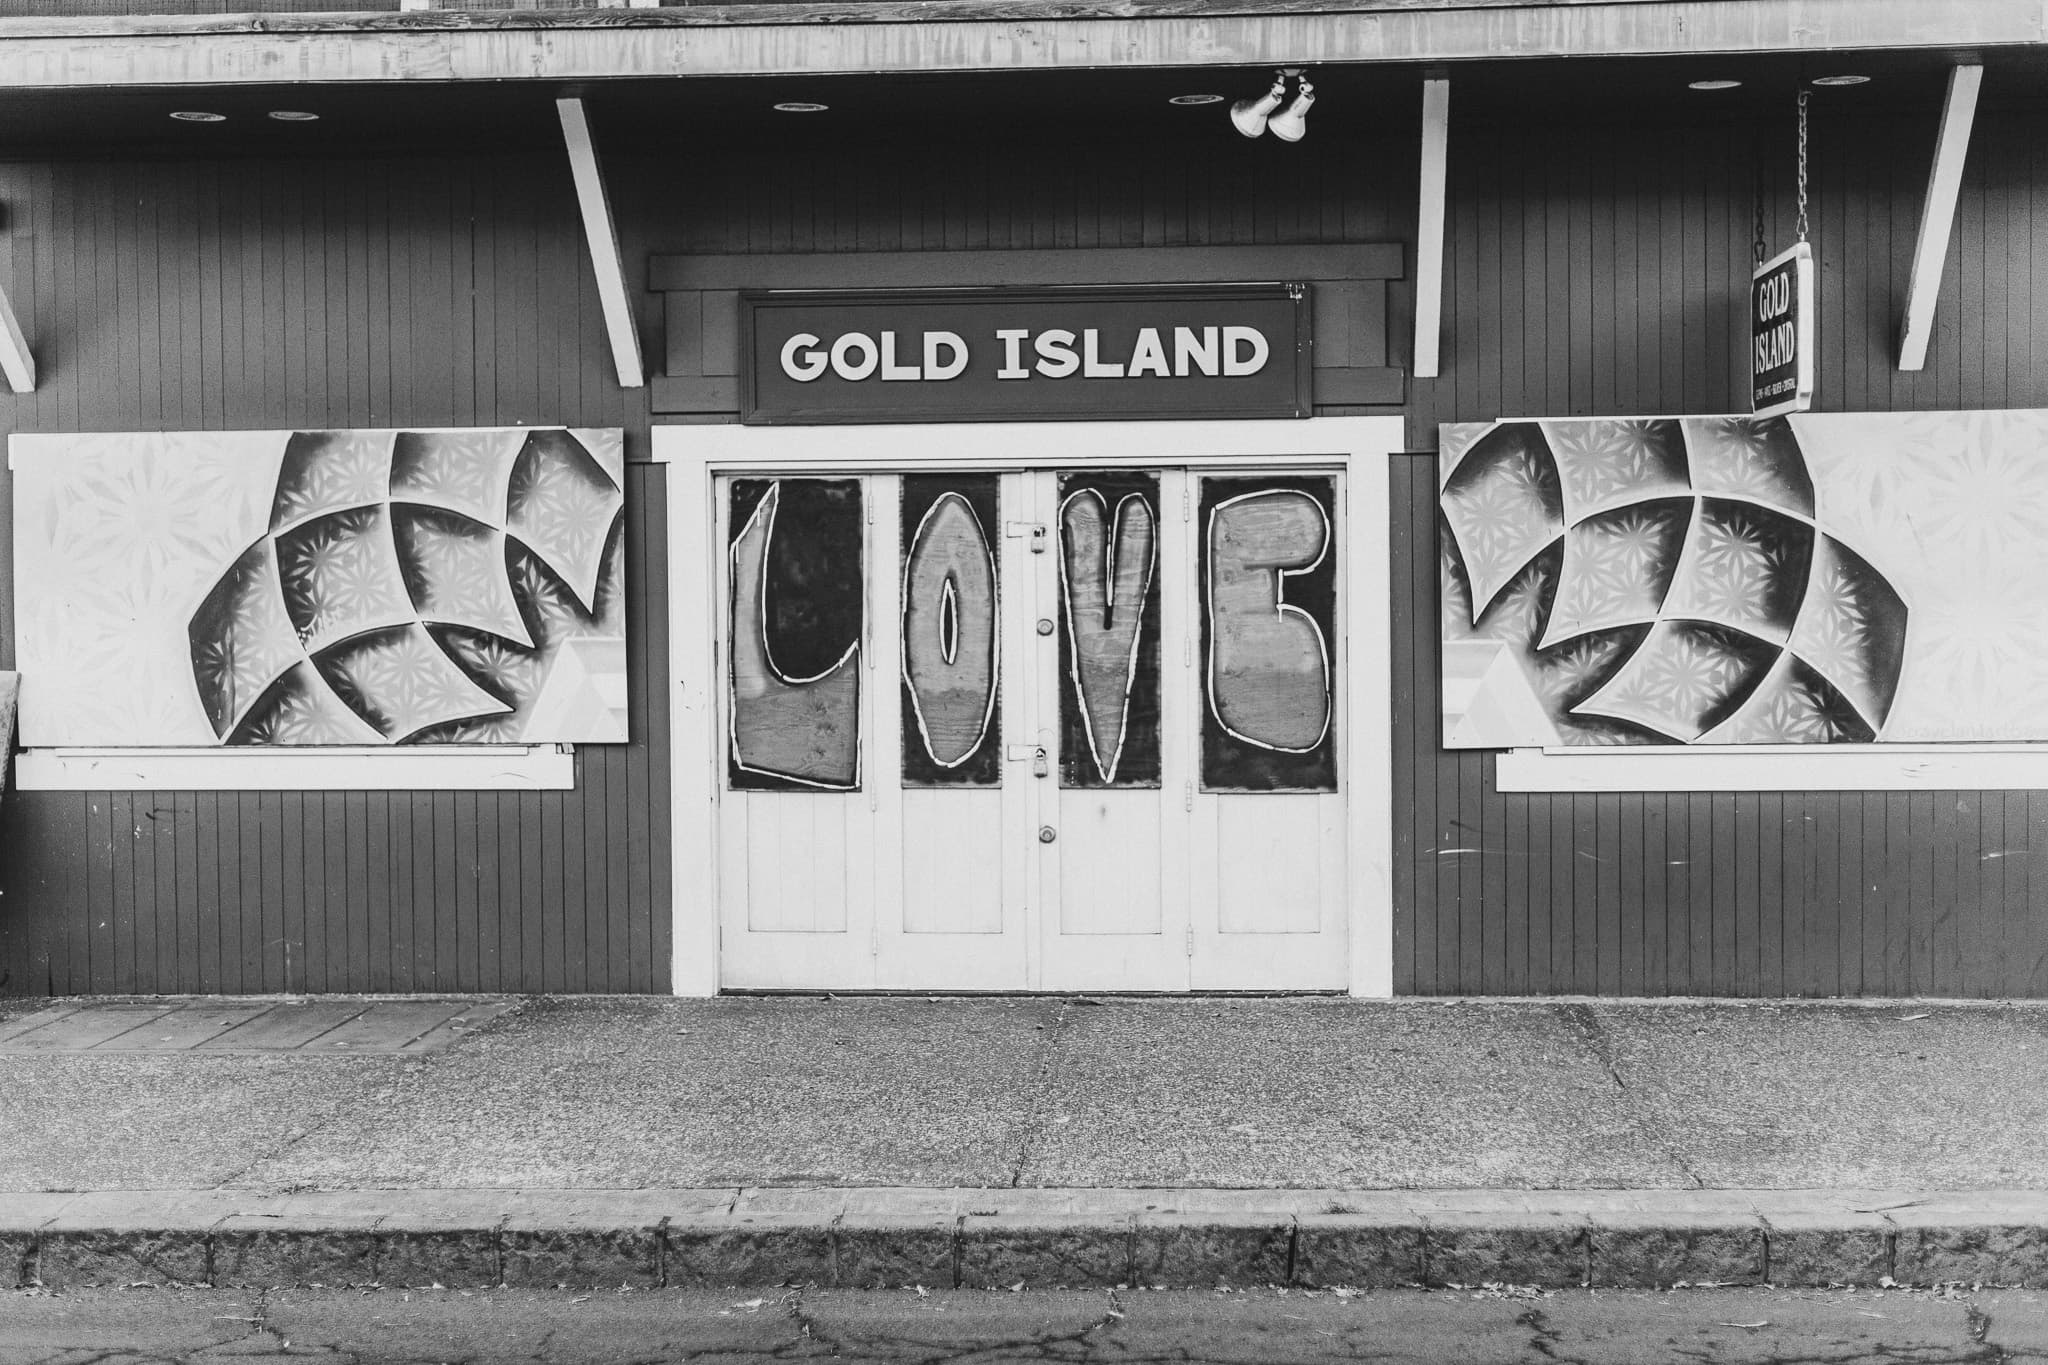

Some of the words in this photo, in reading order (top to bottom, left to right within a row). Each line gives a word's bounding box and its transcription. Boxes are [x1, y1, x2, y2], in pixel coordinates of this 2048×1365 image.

[1760, 272, 1789, 322] GOLD
[780, 330, 969, 382] GOLD
[995, 326, 1270, 379] ISLAND
[1755, 321, 1795, 375] ISLAND
[729, 481, 1331, 788] LOVE
